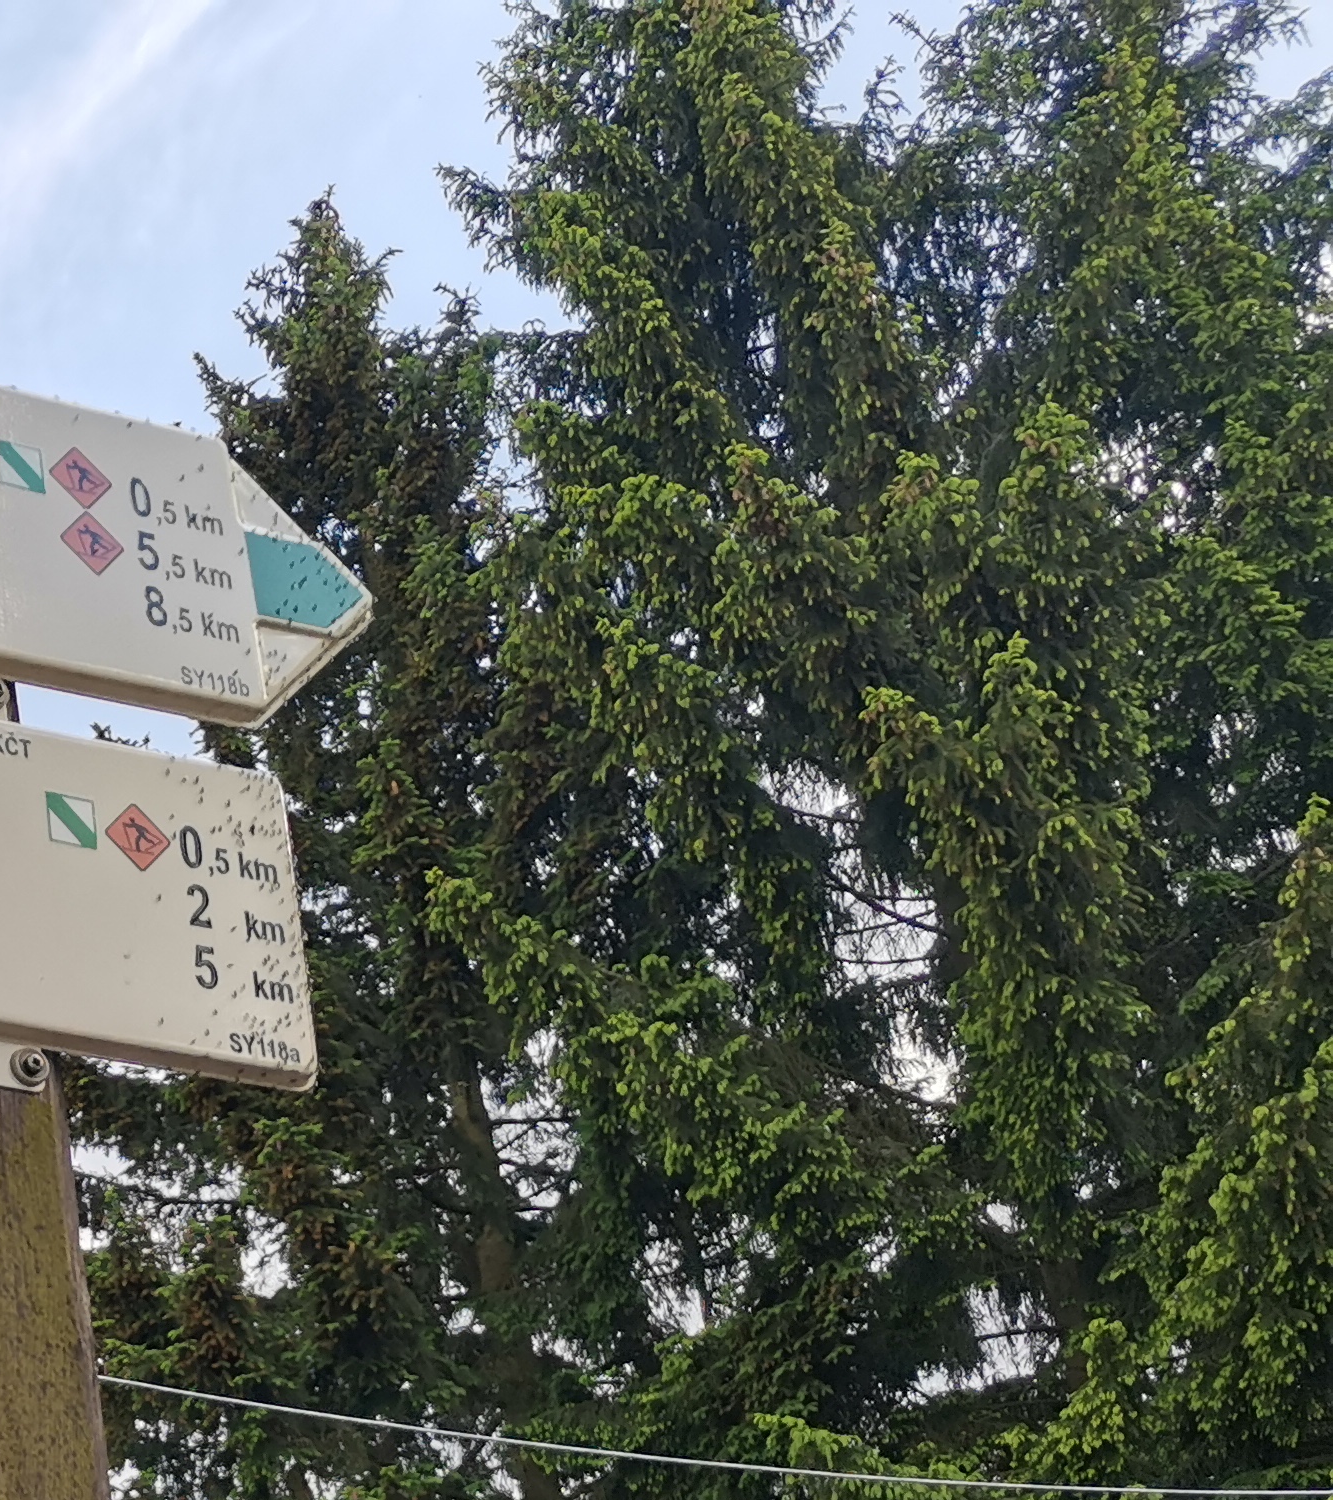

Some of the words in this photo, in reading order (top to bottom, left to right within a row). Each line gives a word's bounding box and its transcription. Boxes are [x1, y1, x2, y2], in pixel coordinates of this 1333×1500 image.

[129, 476, 178, 528] 0,5
[184, 504, 224, 537] km
[136, 530, 187, 583] 5,5
[193, 559, 233, 590] km
[144, 585, 194, 634] 8,5
[201, 613, 241, 644] km
[178, 824, 231, 878] 0,5
[237, 851, 279, 886] km
[186, 884, 213, 930] 2
[243, 910, 286, 946] km
[194, 944, 219, 990] 5
[252, 970, 295, 1004] km
[228, 1031, 301, 1065] SY118a
